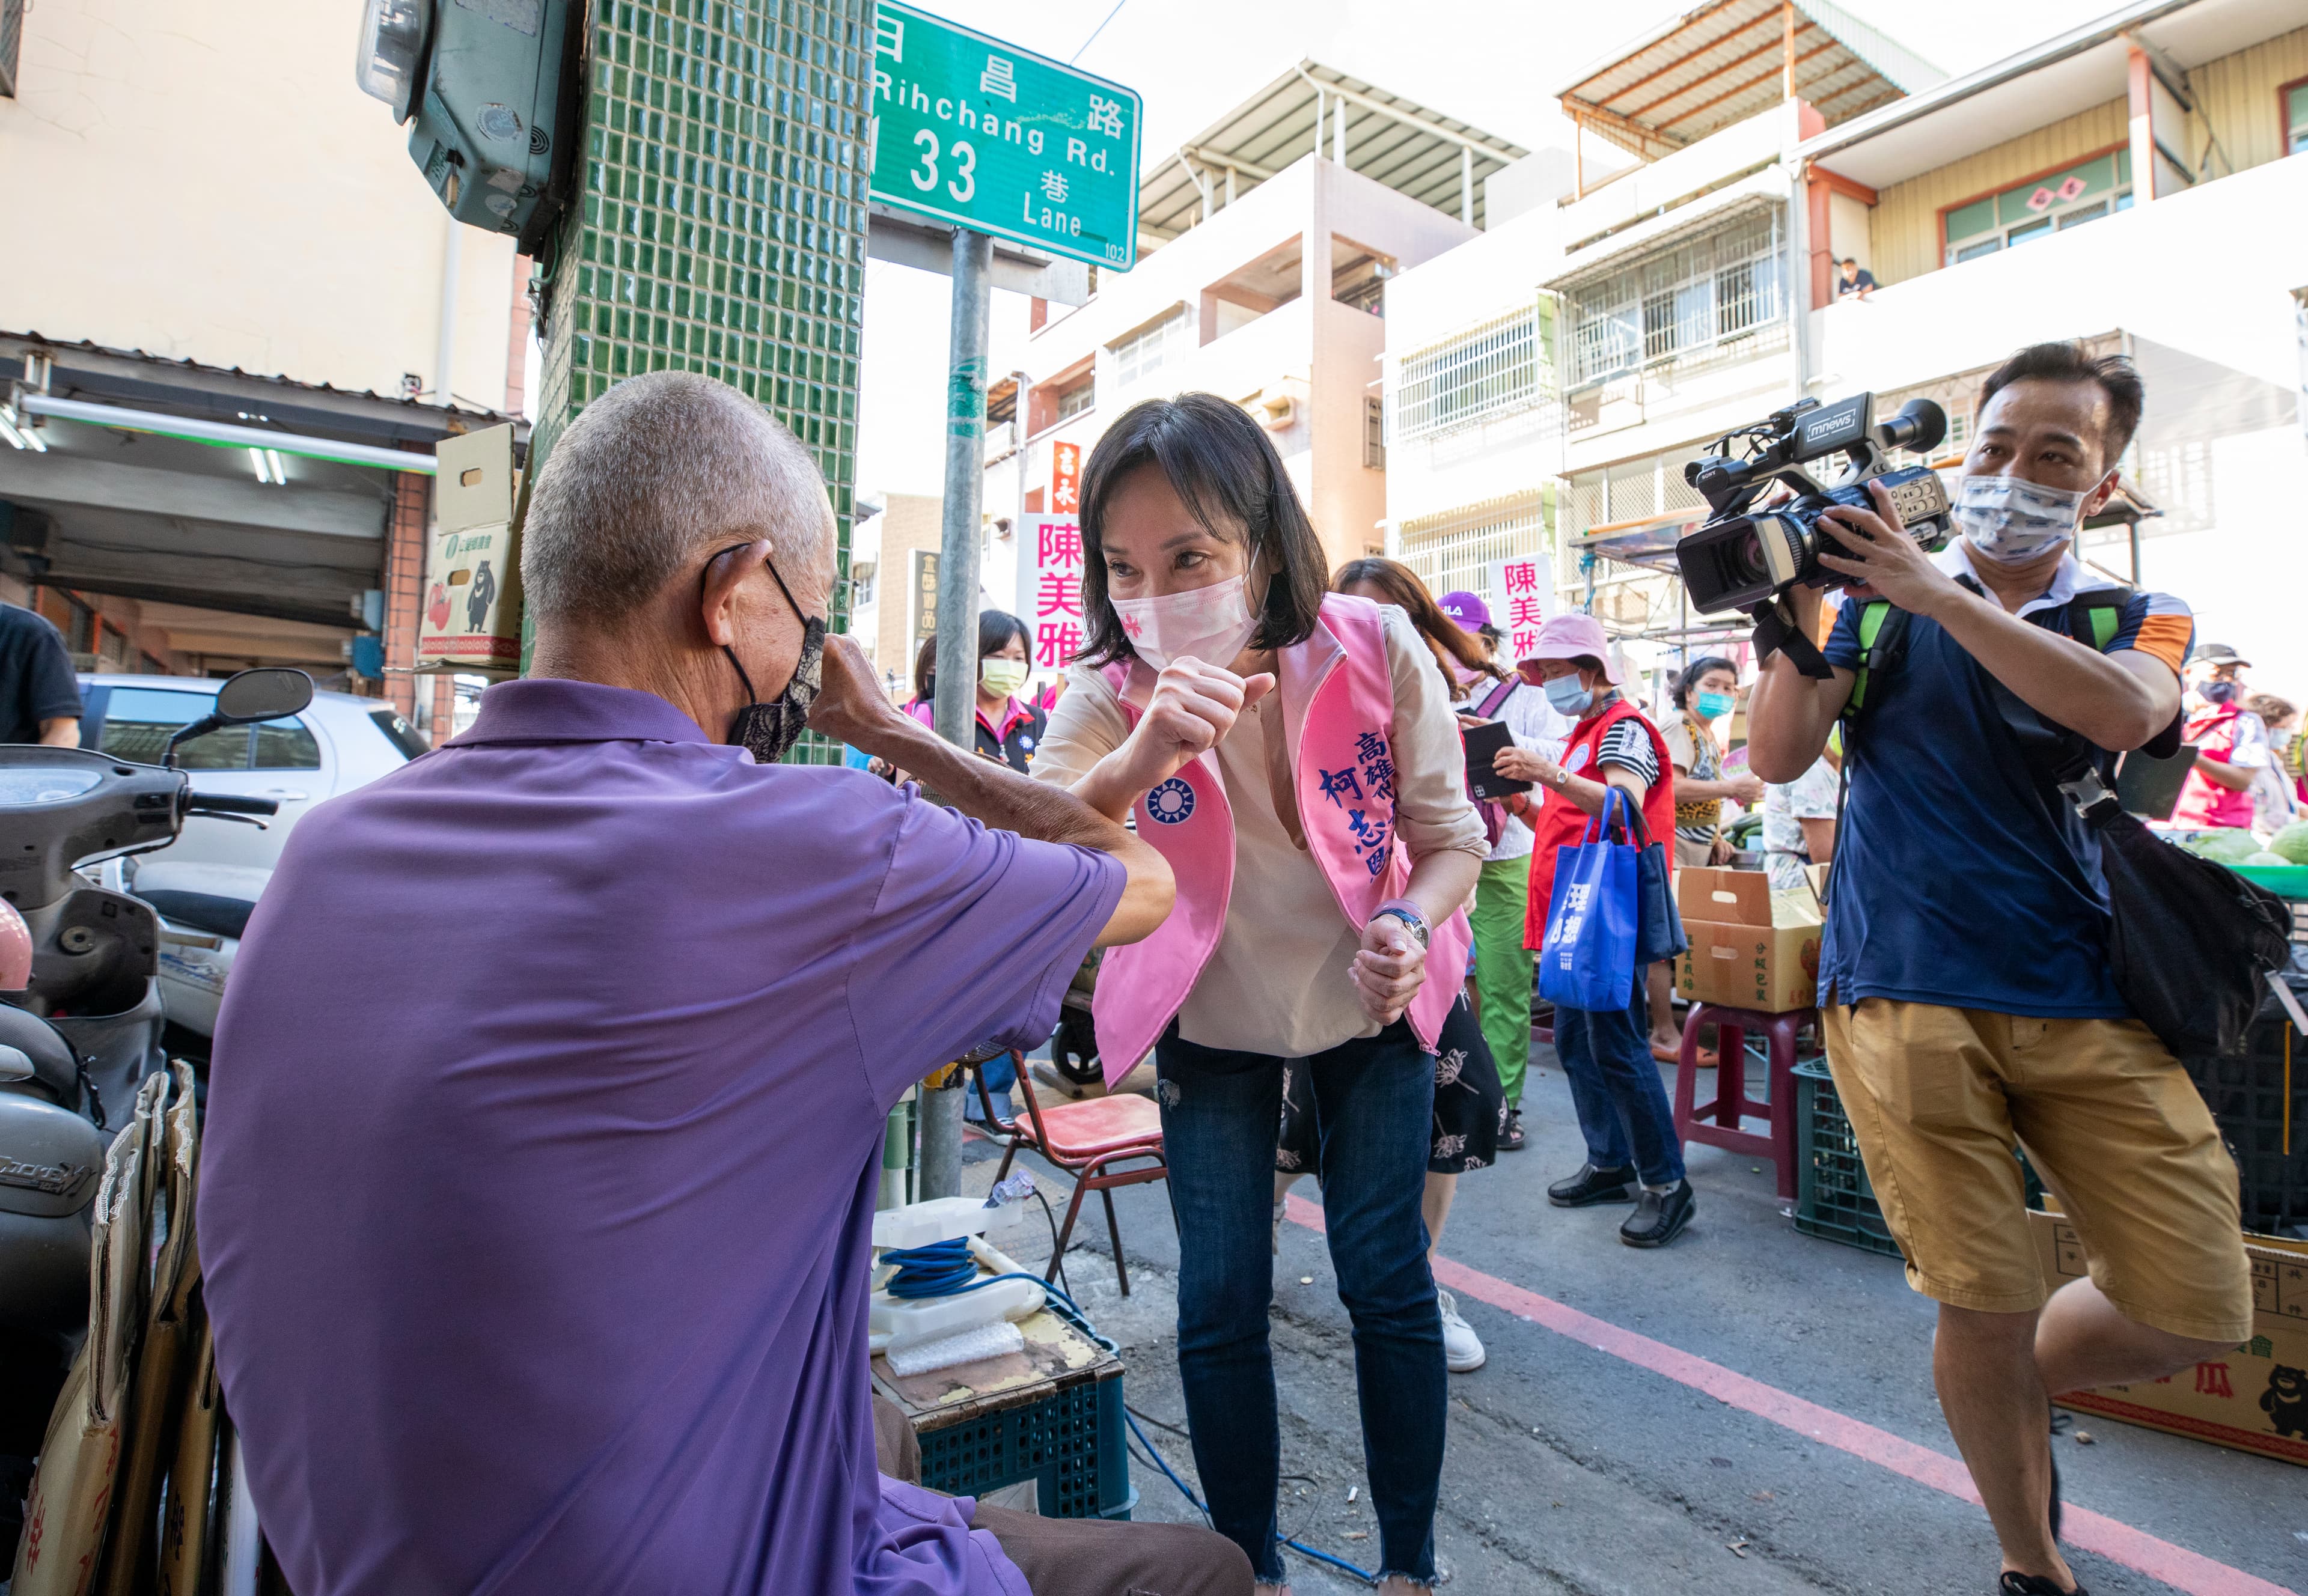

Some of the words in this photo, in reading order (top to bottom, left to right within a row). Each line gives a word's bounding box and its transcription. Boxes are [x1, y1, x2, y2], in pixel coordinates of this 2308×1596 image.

[875, 73, 1044, 155] Rihchang
[1067, 137, 1115, 176] Rd.
[1041, 169, 1069, 204] 巷
[1023, 192, 1081, 237] Lane
[1105, 243, 1124, 262] 102
[1811, 415, 1851, 436] mnews
[1702, 470, 1716, 480] SONY
[1036, 523, 1082, 668] 陳美雅
[1441, 605, 1463, 616] ILA
